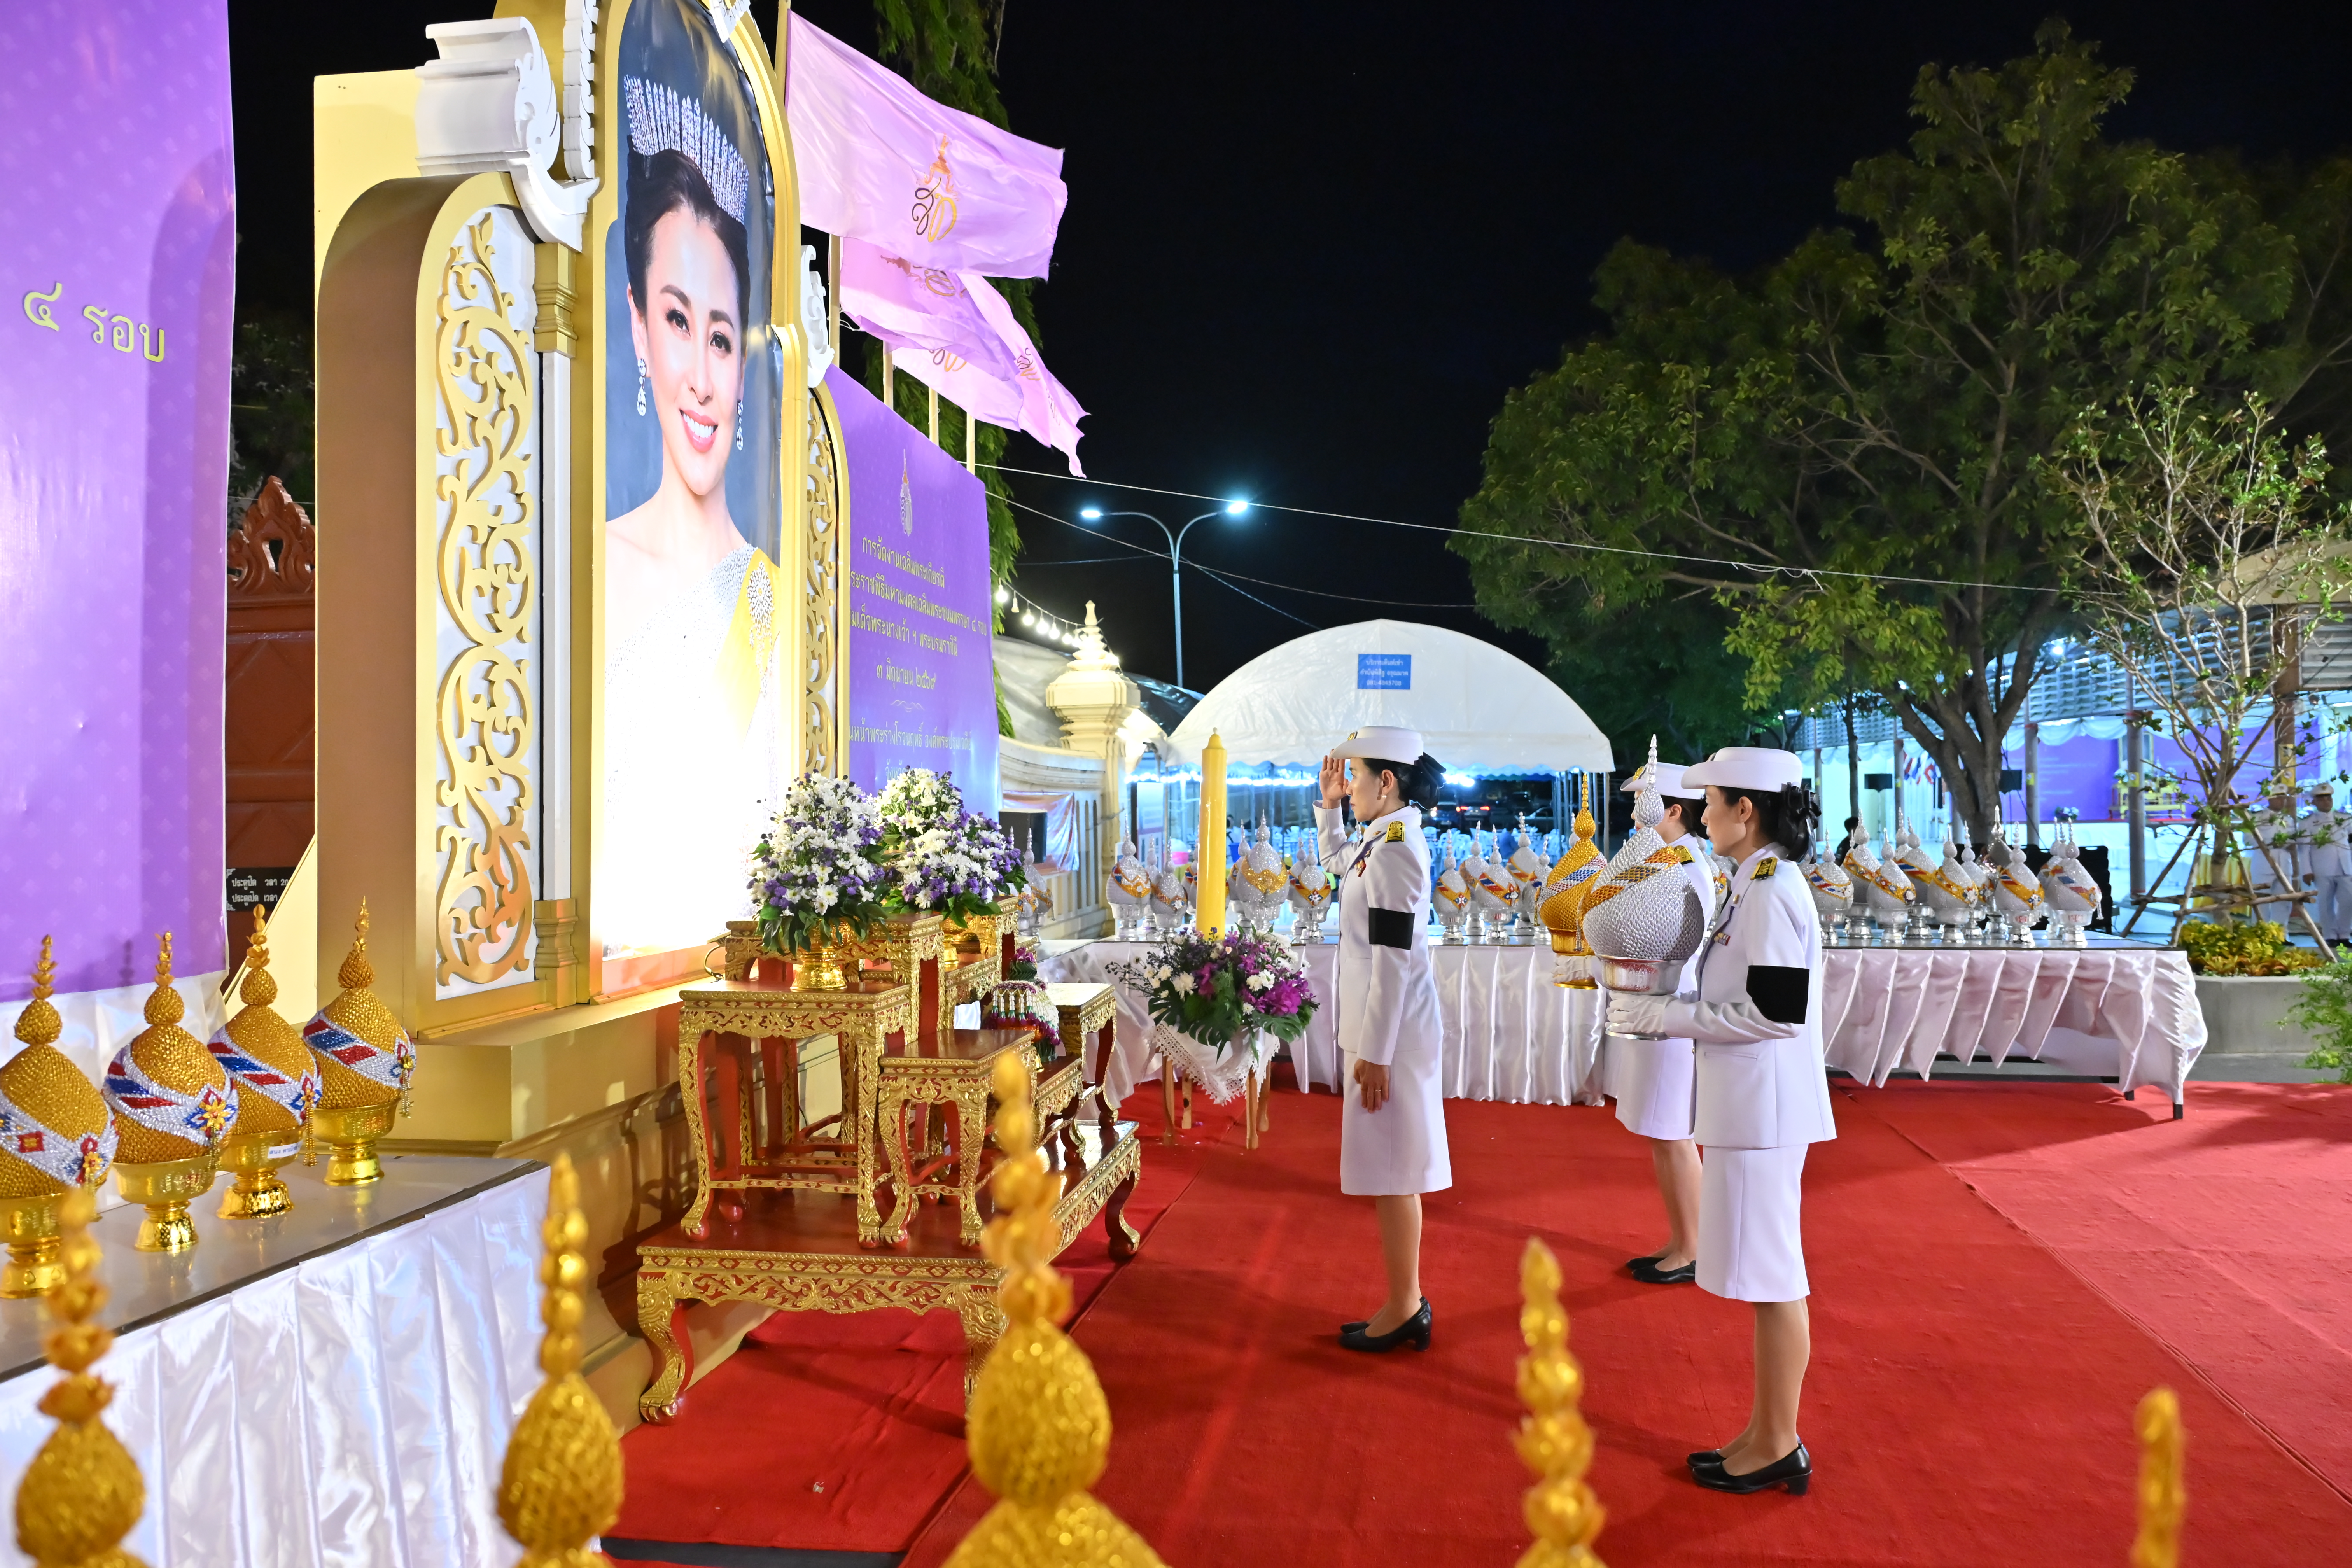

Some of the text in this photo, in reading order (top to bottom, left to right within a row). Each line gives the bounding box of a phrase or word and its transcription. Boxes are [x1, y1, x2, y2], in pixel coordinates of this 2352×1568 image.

[24, 282, 164, 362] ๔ รอบ
[862, 536, 945, 588] การจัดงานเฉลิมพระเกียรติ
[849, 603, 909, 643] มเด็จพระนางเจ้า
[919, 635, 957, 656] พระบรมราชินี
[971, 616, 976, 632] ๔
[978, 621, 987, 636] รอบ
[877, 657, 936, 690] ๓ มิถุนายน ๒๕๖๙
[231, 875, 257, 890] ประตูปิด
[232, 891, 259, 906] ประตูเปิด
